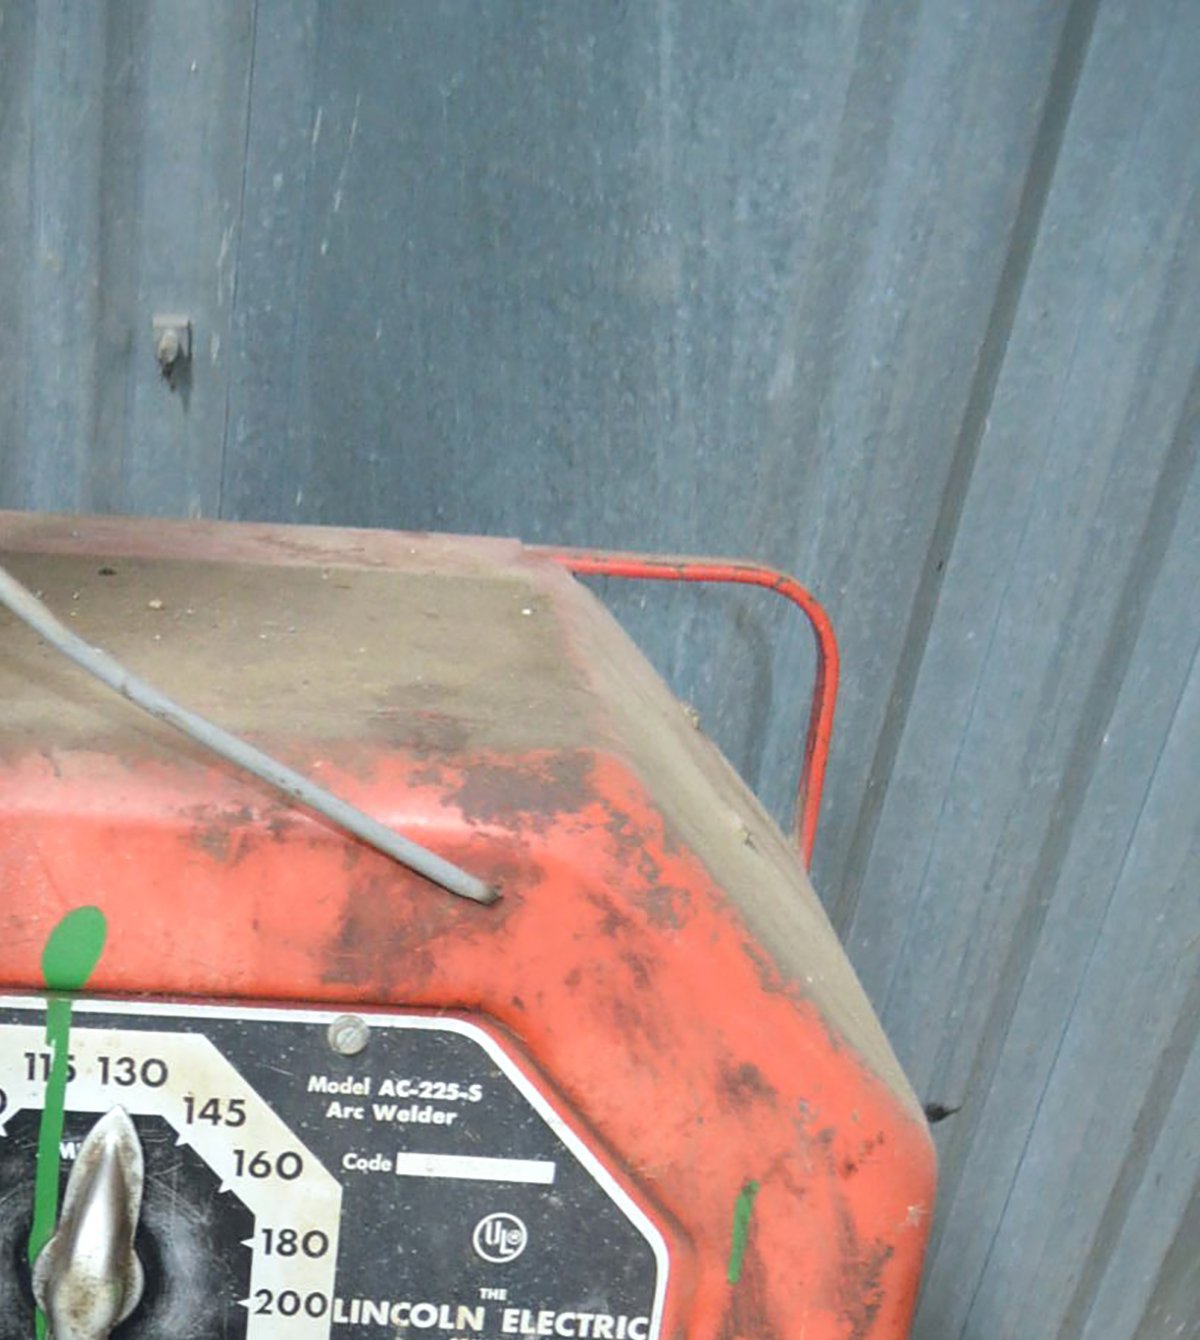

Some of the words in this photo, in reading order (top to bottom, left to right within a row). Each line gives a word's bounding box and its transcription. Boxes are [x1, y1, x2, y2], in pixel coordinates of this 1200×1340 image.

[98, 1056, 168, 1088] 130
[308, 1076, 371, 1096] Model
[379, 1079, 482, 1101] AC-225-S
[184, 1096, 247, 1127] 145
[326, 1102, 364, 1121] Arc
[372, 1104, 458, 1125] Welder
[233, 1149, 303, 1180] 160
[342, 1153, 392, 1173] Code
[261, 1228, 329, 1258] 180
[254, 1290, 326, 1318] 200
[479, 1288, 507, 1300] THE
[332, 1299, 485, 1331] LINCOLN
[501, 1308, 649, 1340] ELECTRIC
